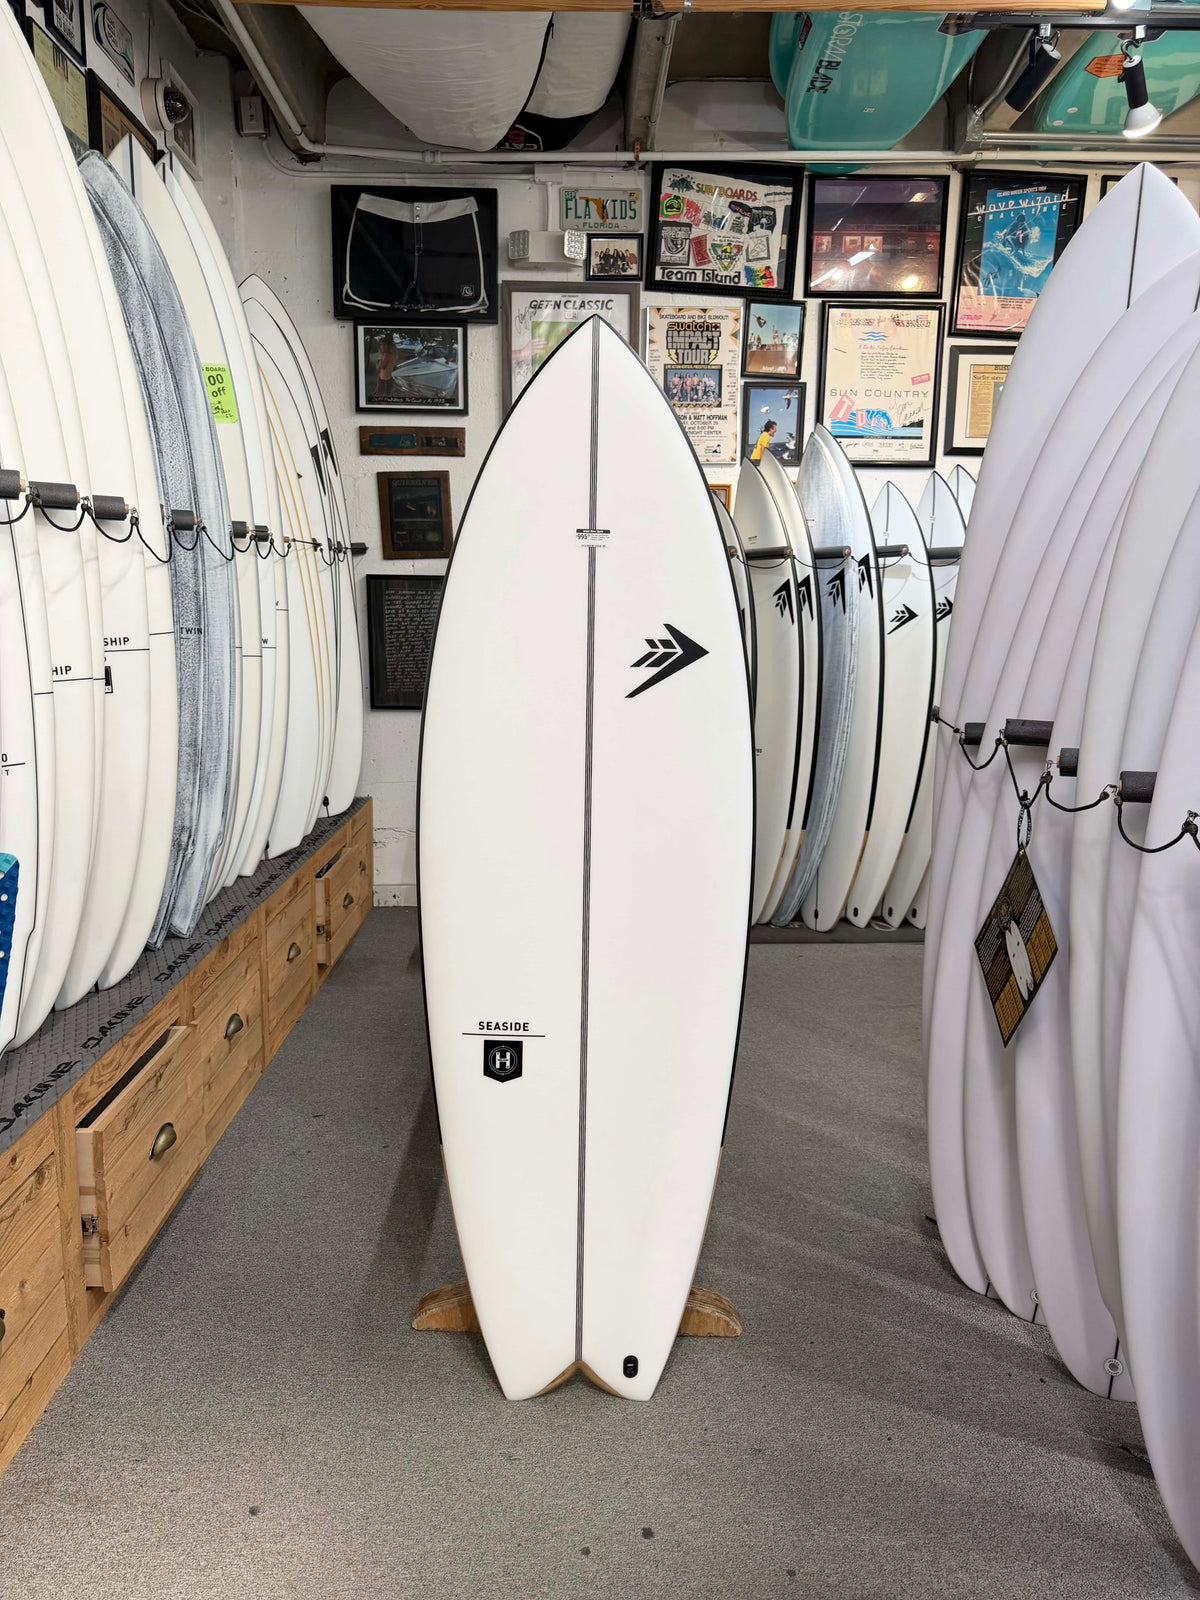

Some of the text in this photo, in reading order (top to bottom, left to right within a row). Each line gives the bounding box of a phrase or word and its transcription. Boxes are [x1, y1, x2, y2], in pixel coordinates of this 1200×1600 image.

[696, 183, 758, 202] SURFBOARDS
[565, 199, 637, 220] FLA KIDS
[660, 267, 741, 284] Team Island
[563, 299, 614, 310] CLASSIC
[667, 320, 711, 331] swatch
[667, 330, 721, 350] IMPACT
[677, 349, 709, 364] TOUR
[830, 389, 929, 398] SUN COUNTRY
[180, 626, 203, 635] TWIN
[153, 941, 207, 982] DAKINE
[80, 994, 151, 1050] DAKINE
[478, 1021, 530, 1032] SEASIDE
